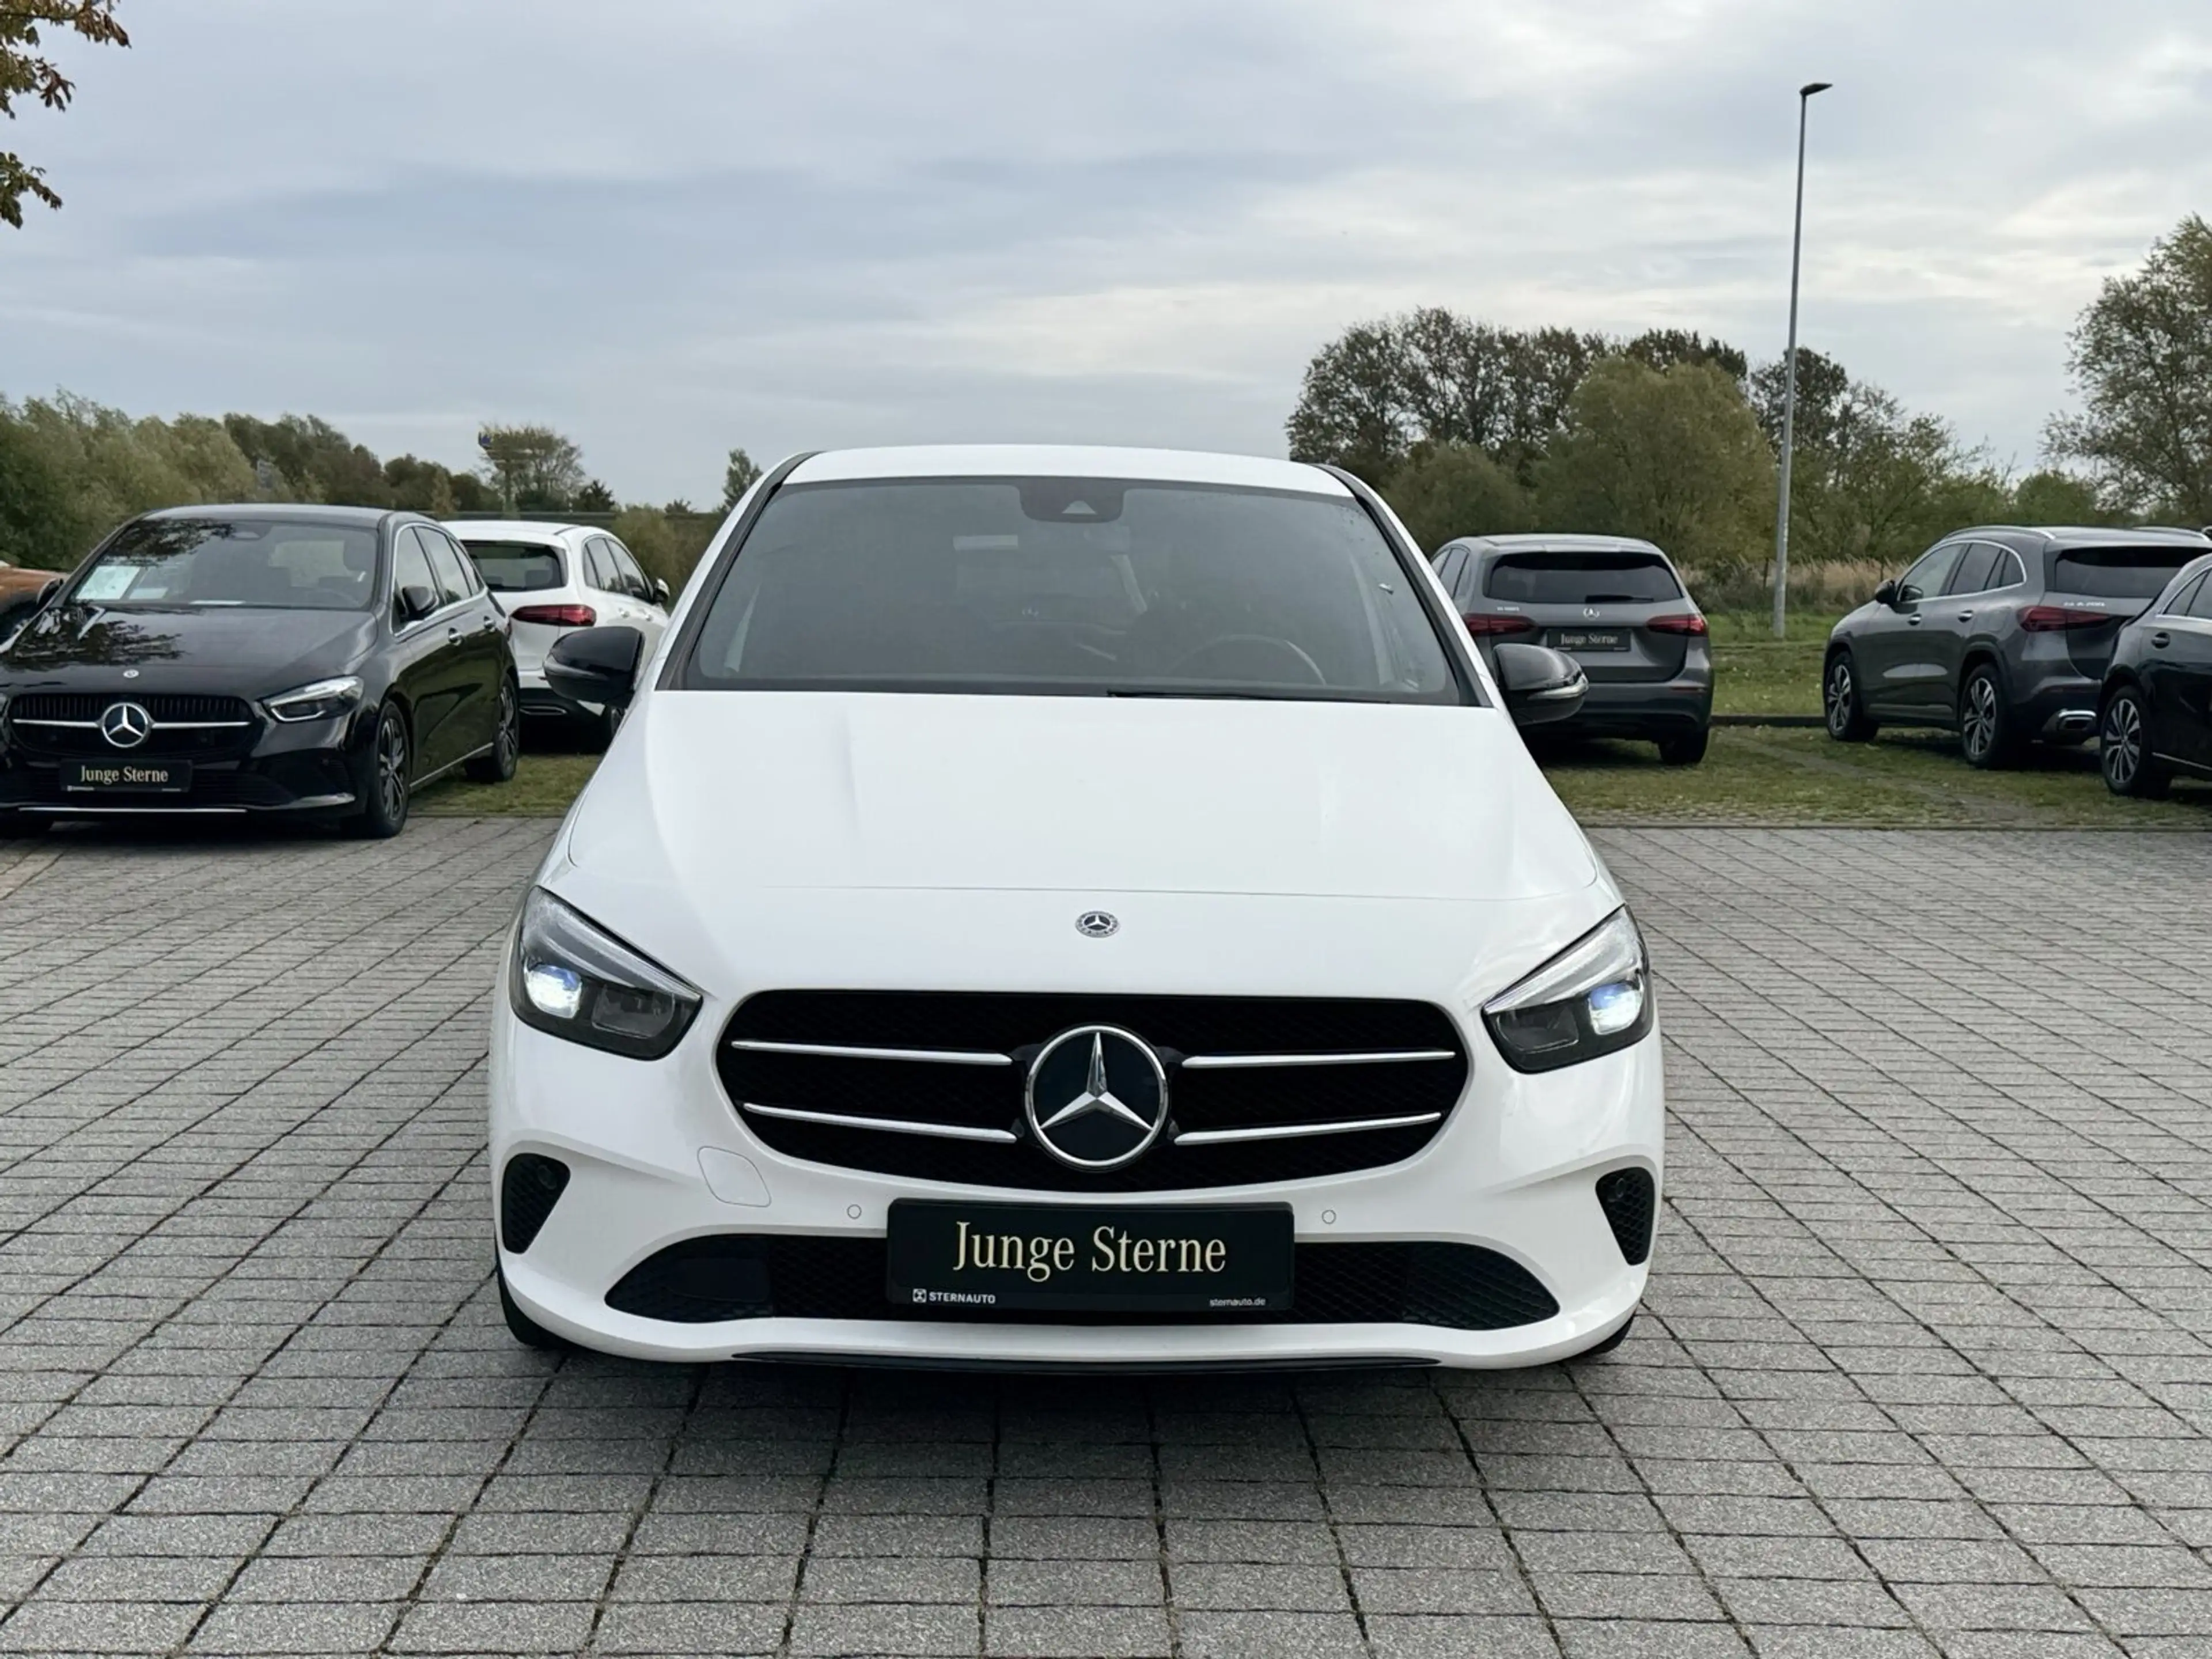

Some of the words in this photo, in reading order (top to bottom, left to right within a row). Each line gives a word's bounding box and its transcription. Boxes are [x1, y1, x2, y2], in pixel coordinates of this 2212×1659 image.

[80, 764, 120, 785] Junge
[123, 766, 169, 782] Sterne
[953, 1221, 1075, 1282] Junge
[1092, 1226, 1226, 1272] Sterne
[929, 1291, 996, 1304] STERNAUTO
[1210, 1297, 1266, 1307] sternauto.de
